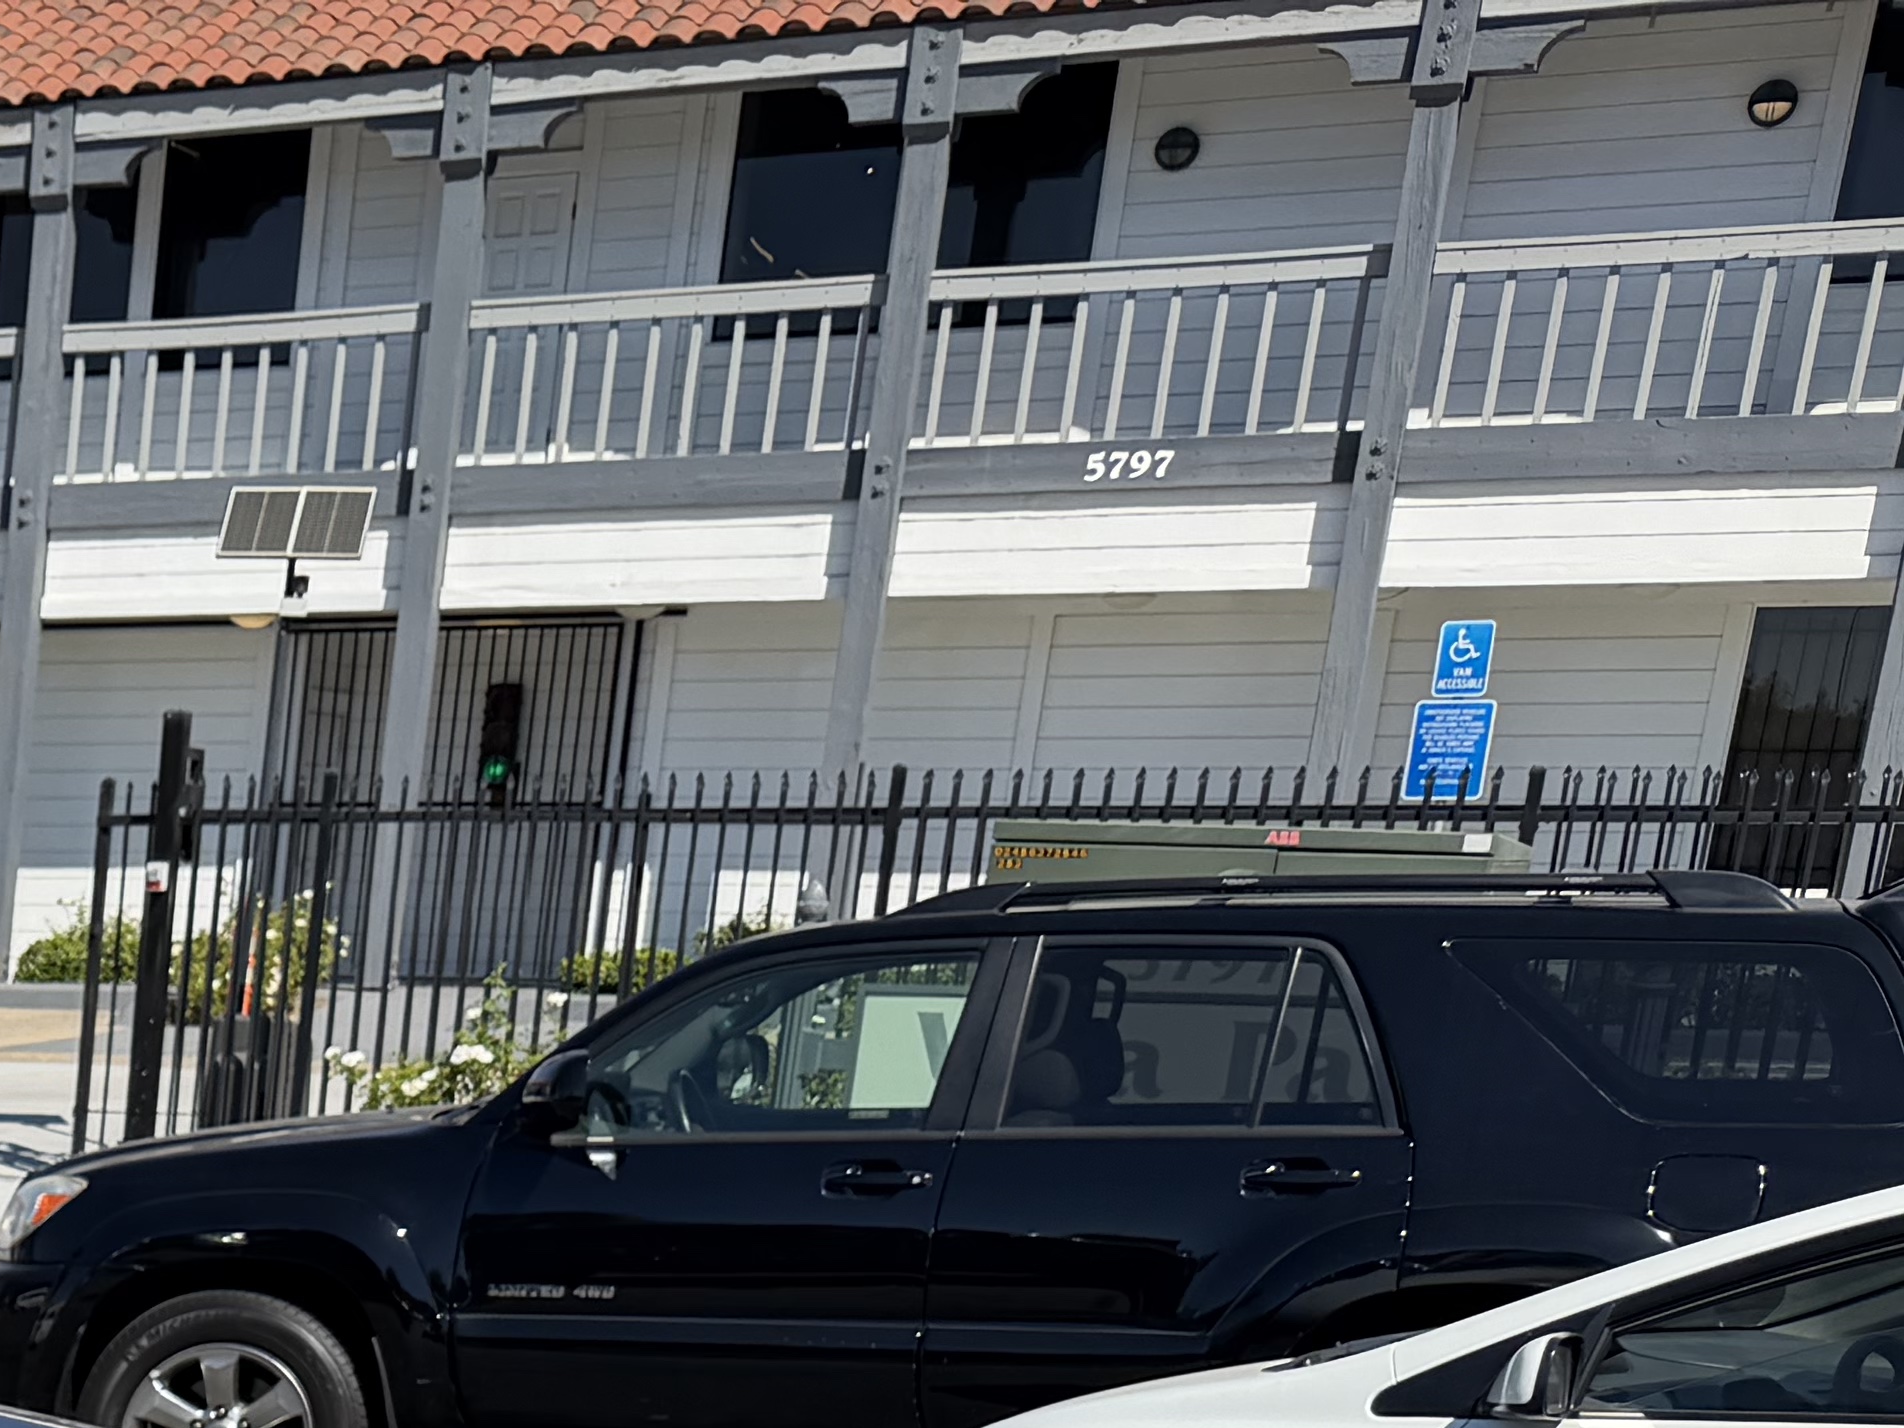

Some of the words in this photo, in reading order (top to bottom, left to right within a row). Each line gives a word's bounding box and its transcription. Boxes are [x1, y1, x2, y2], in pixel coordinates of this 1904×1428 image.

[1083, 449, 1176, 482] 5797
[1265, 830, 1301, 846] ABB
[572, 1284, 616, 1300] 4WD
